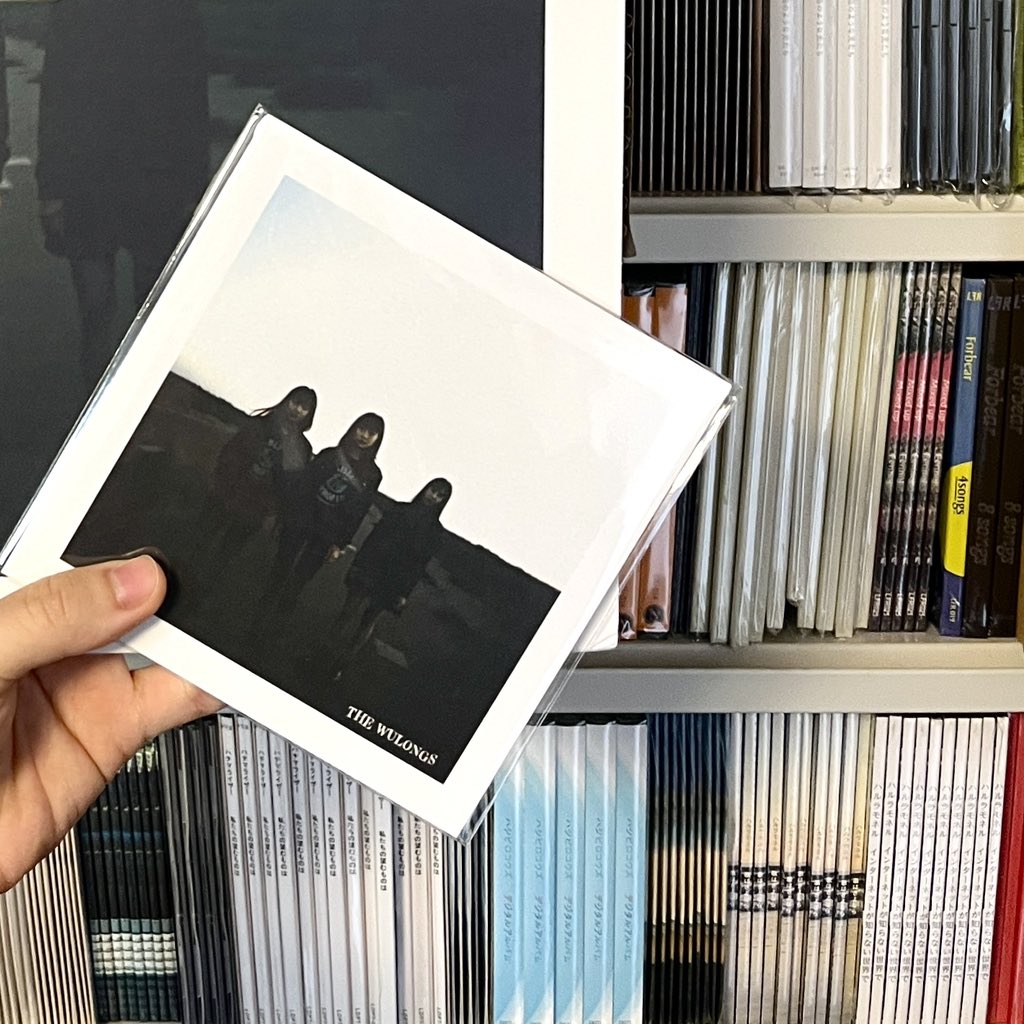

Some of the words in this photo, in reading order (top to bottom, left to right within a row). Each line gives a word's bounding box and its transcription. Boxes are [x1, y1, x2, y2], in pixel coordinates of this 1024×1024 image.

[963, 336, 977, 382] Forbear
[346, 705, 376, 732] THE
[375, 721, 439, 766] WULONGS
